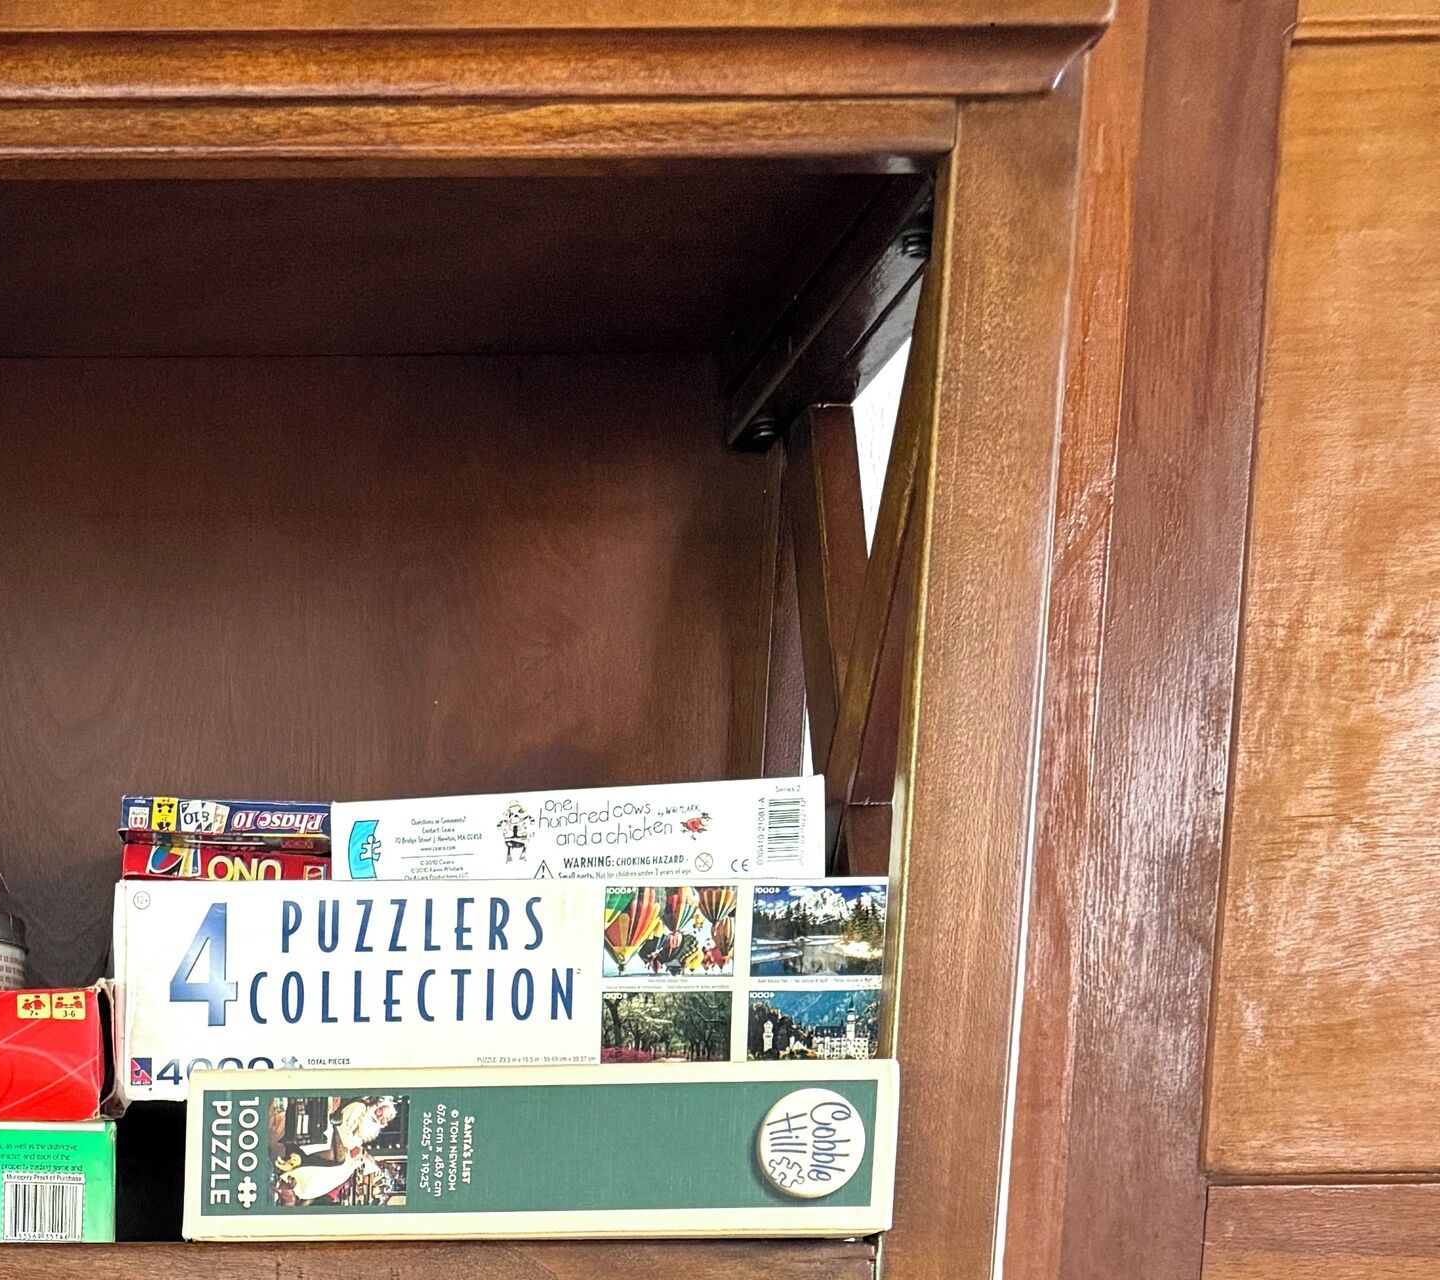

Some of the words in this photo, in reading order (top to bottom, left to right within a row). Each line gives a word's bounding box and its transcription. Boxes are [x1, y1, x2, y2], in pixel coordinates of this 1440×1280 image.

[231, 811, 257, 828] 10
[260, 811, 329, 833] Phase
[539, 800, 610, 829] hundred
[613, 803, 651, 818] cows
[545, 799, 573, 813] one
[557, 826, 588, 846] and
[591, 831, 602, 845] a
[605, 819, 673, 845] chicken
[563, 856, 615, 869] WARNING:
[616, 857, 651, 866] CHOKING
[652, 855, 685, 865] HAZARD
[281, 898, 544, 953] PUZZLERS
[169, 901, 239, 1027] 4
[250, 968, 576, 1025] COLLECTION
[307, 1058, 327, 1066] TOTAL
[238, 1096, 260, 1172] 1000
[766, 1112, 808, 1154] Hill
[807, 1102, 852, 1181] Cobble
[210, 1100, 233, 1205] PUZZLE
